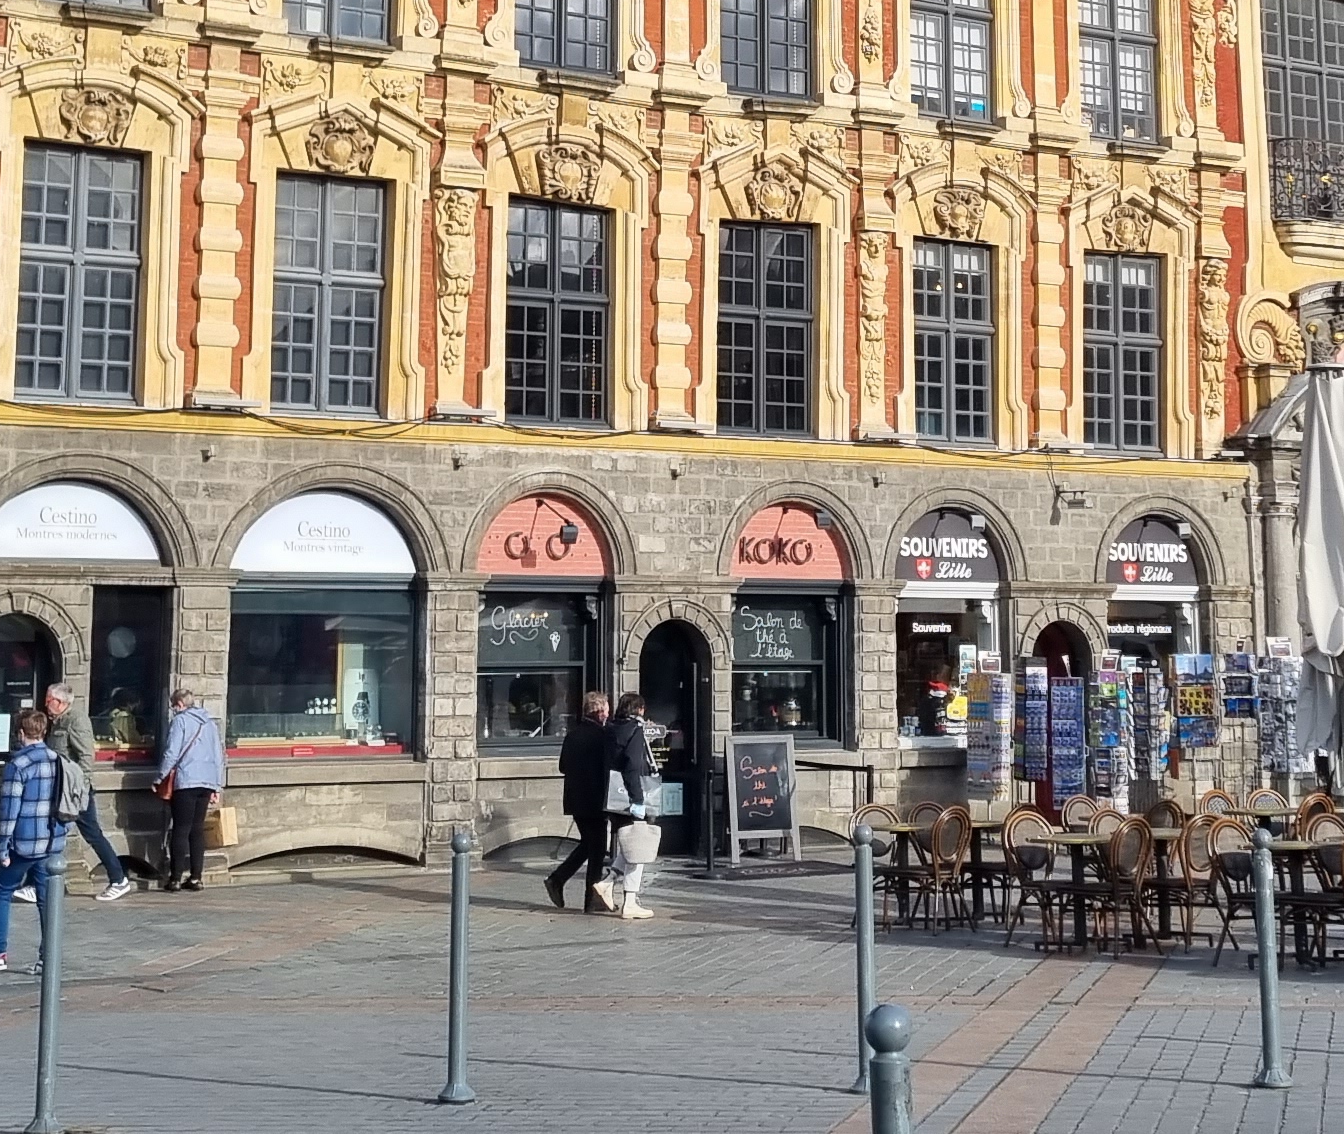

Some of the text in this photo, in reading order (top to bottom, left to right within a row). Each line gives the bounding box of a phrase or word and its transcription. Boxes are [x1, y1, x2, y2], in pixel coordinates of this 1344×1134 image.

[39, 506, 97, 525] Cestino
[16, 527, 118, 541] Montres modernes
[297, 520, 351, 538] Cestino
[283, 540, 364, 556] Montres vintage
[738, 536, 814, 566] KOKO
[899, 536, 989, 559] SOUVENIRS
[1108, 542, 1189, 563] SOUVENIRS
[934, 560, 973, 579] Lille
[1139, 565, 1174, 583] Lille
[490, 605, 549, 646] Glacier
[740, 605, 804, 631] Salon de
[912, 622, 952, 633] Souvenirs
[756, 627, 789, 644] thé à
